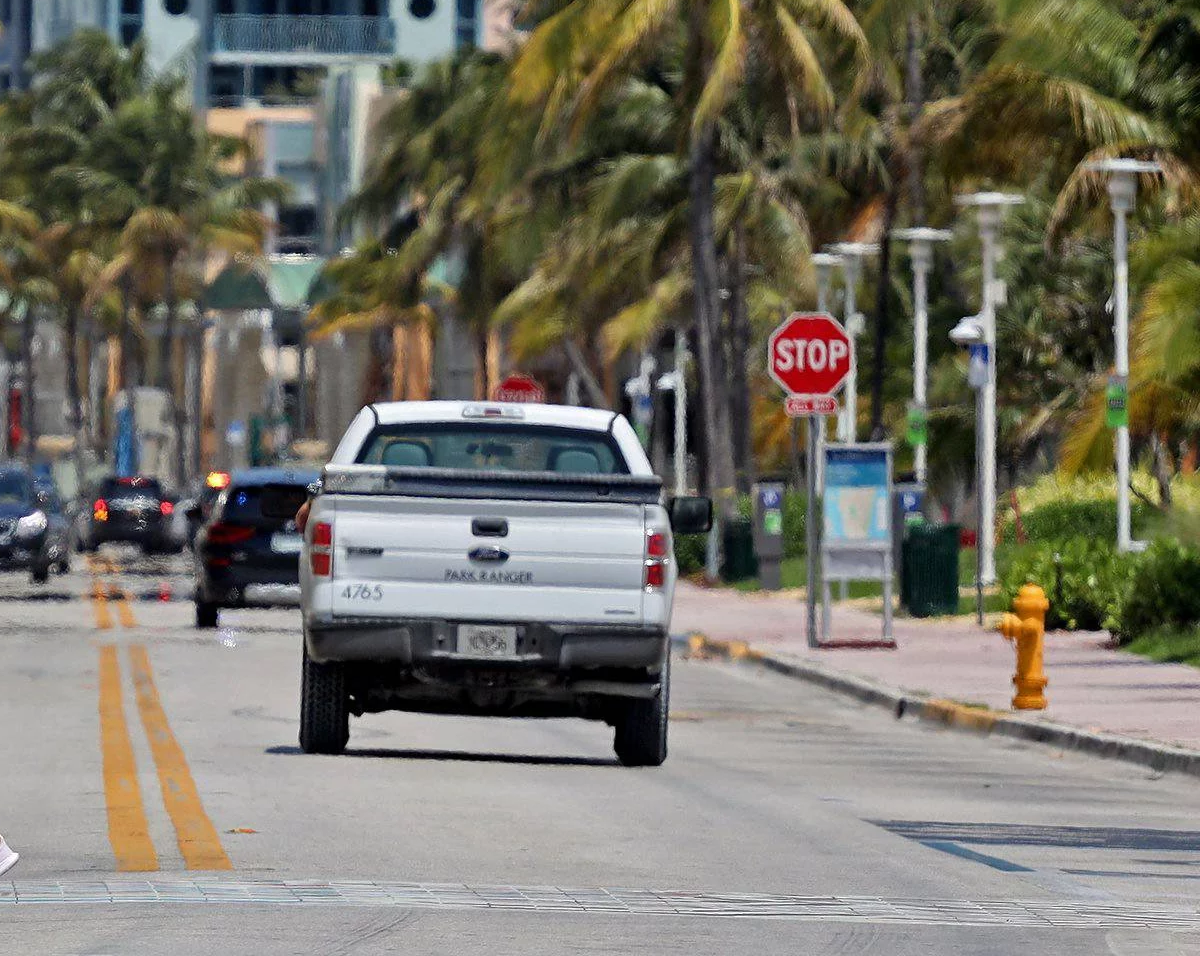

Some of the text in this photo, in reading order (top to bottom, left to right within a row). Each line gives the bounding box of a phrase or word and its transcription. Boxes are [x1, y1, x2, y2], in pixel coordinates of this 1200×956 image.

[776, 338, 848, 373] STOP
[444, 569, 534, 584] PARK RANGER
[341, 584, 384, 601] 4765
